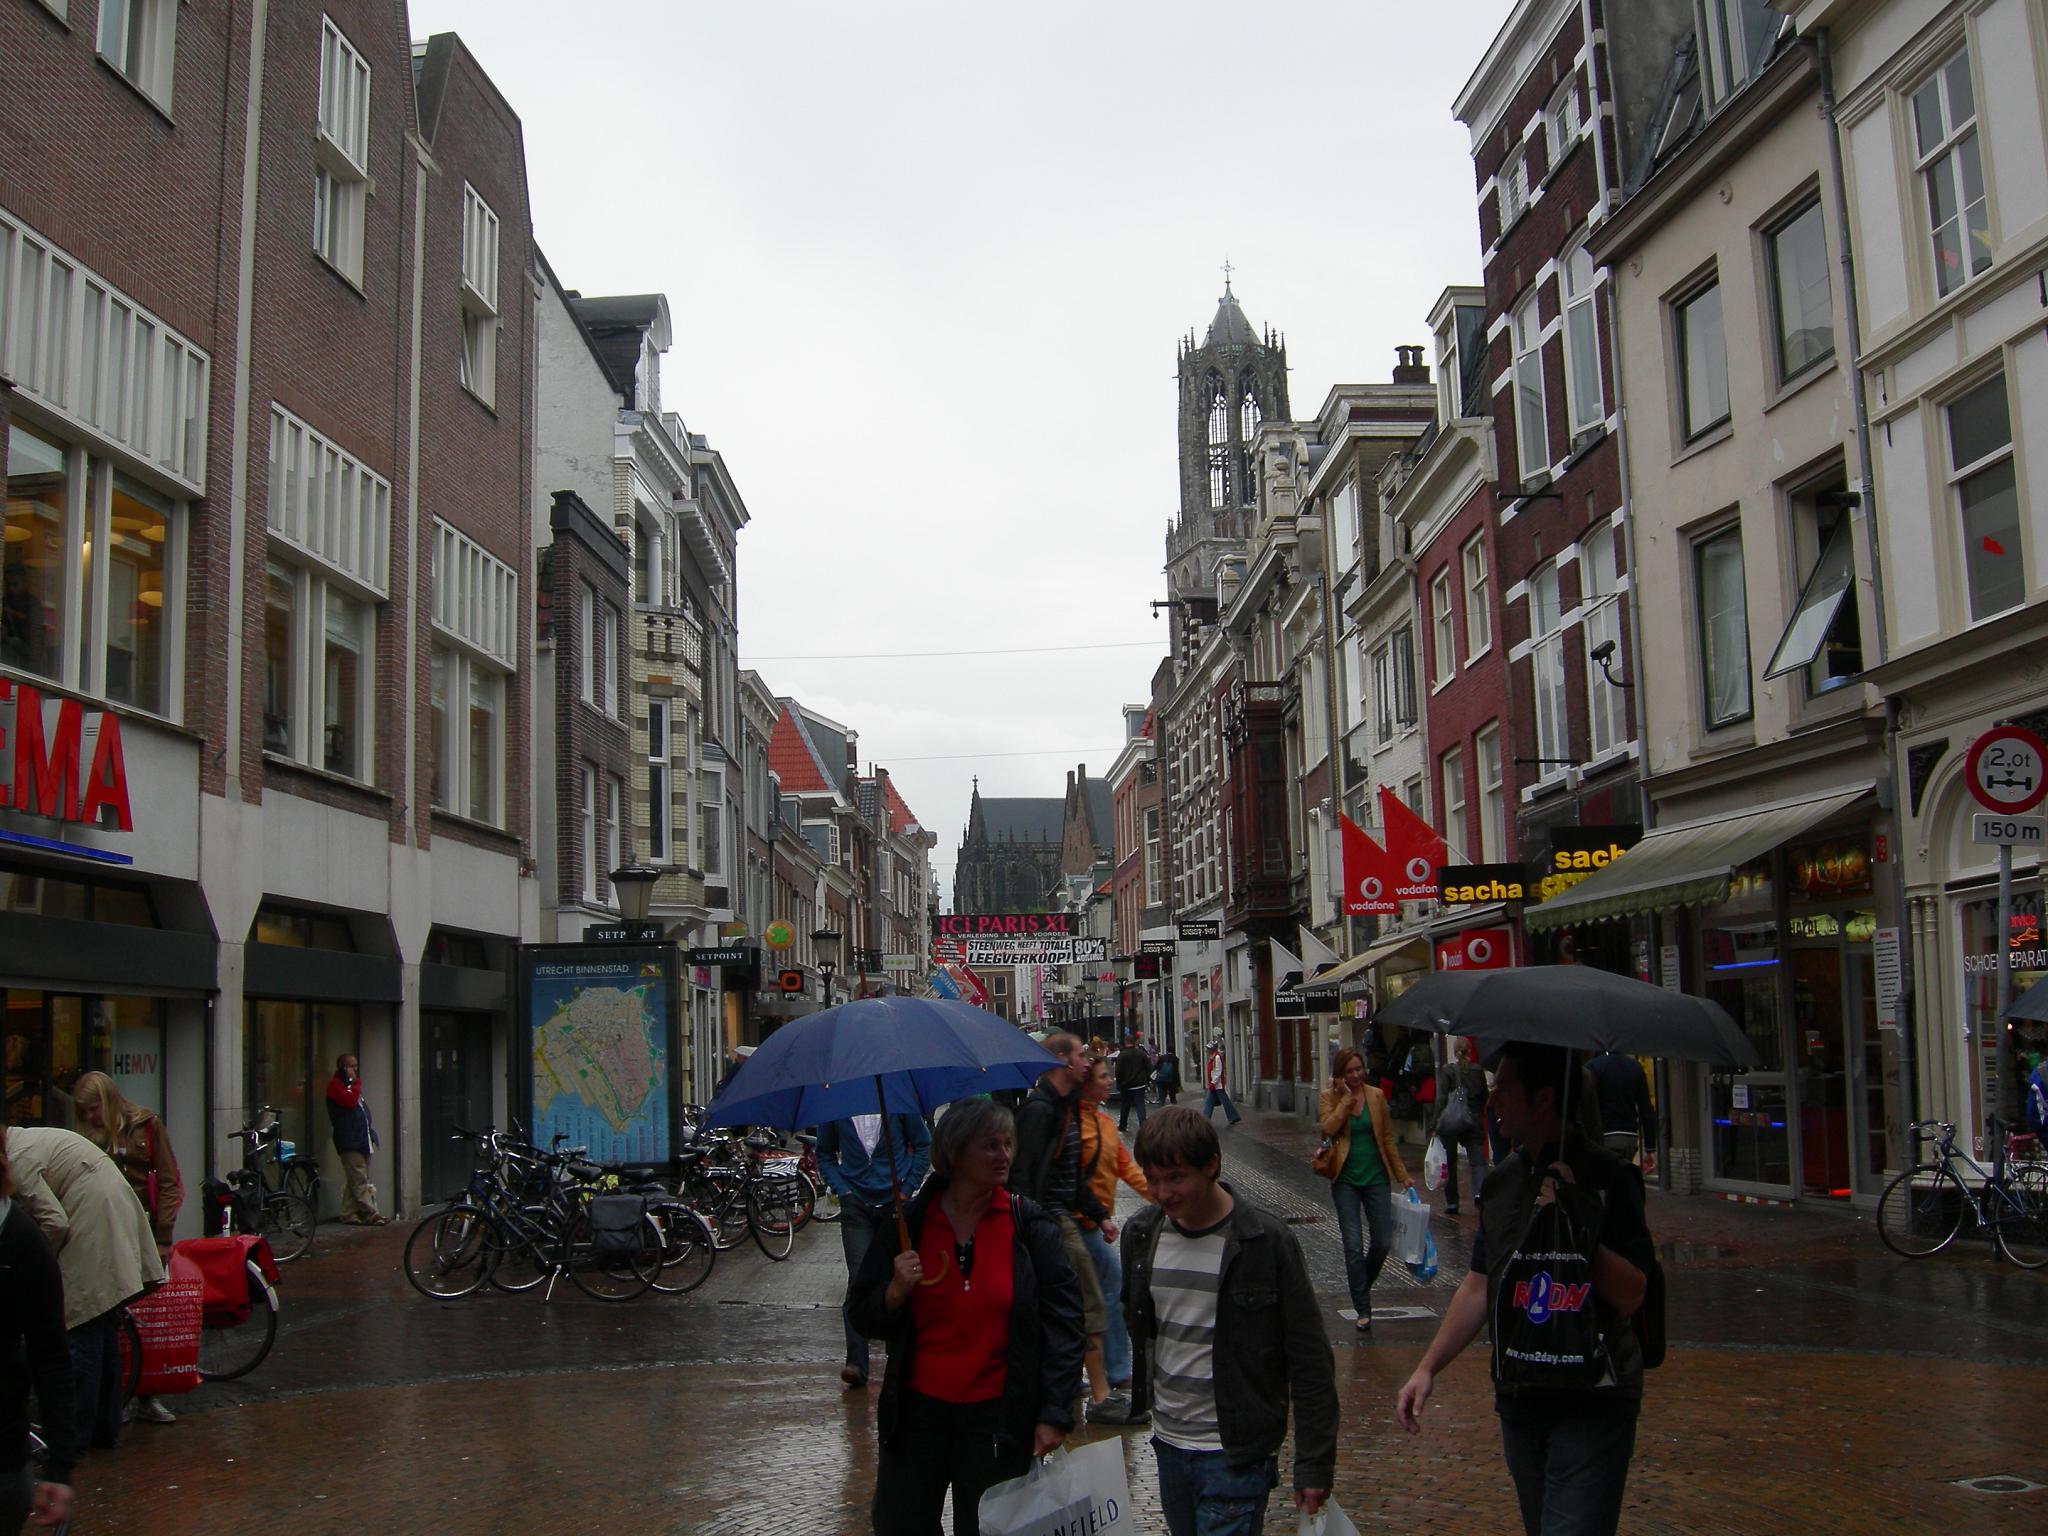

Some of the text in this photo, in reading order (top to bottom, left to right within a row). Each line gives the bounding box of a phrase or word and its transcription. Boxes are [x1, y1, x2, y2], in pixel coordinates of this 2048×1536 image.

[1983, 822, 2040, 839] 150 m
[1555, 844, 1626, 869] sach
[1396, 884, 1438, 895] vodafon
[1444, 880, 1523, 902] sacha
[1350, 902, 1395, 910] vodafone
[940, 915, 1070, 934] ICI PARIS XL
[597, 930, 657, 939] SETPNT
[968, 940, 1070, 950] STEENWEG HEEFT TOTALE
[1074, 939, 1105, 955] 80%
[695, 952, 744, 961] SETPOINT
[968, 952, 1072, 964] LEEGVERKOOP!
[536, 964, 630, 975] UTRECHT BINNENSTAD
[1307, 990, 1338, 998] markt
[1042, 1499, 1119, 1536] NFIELD
